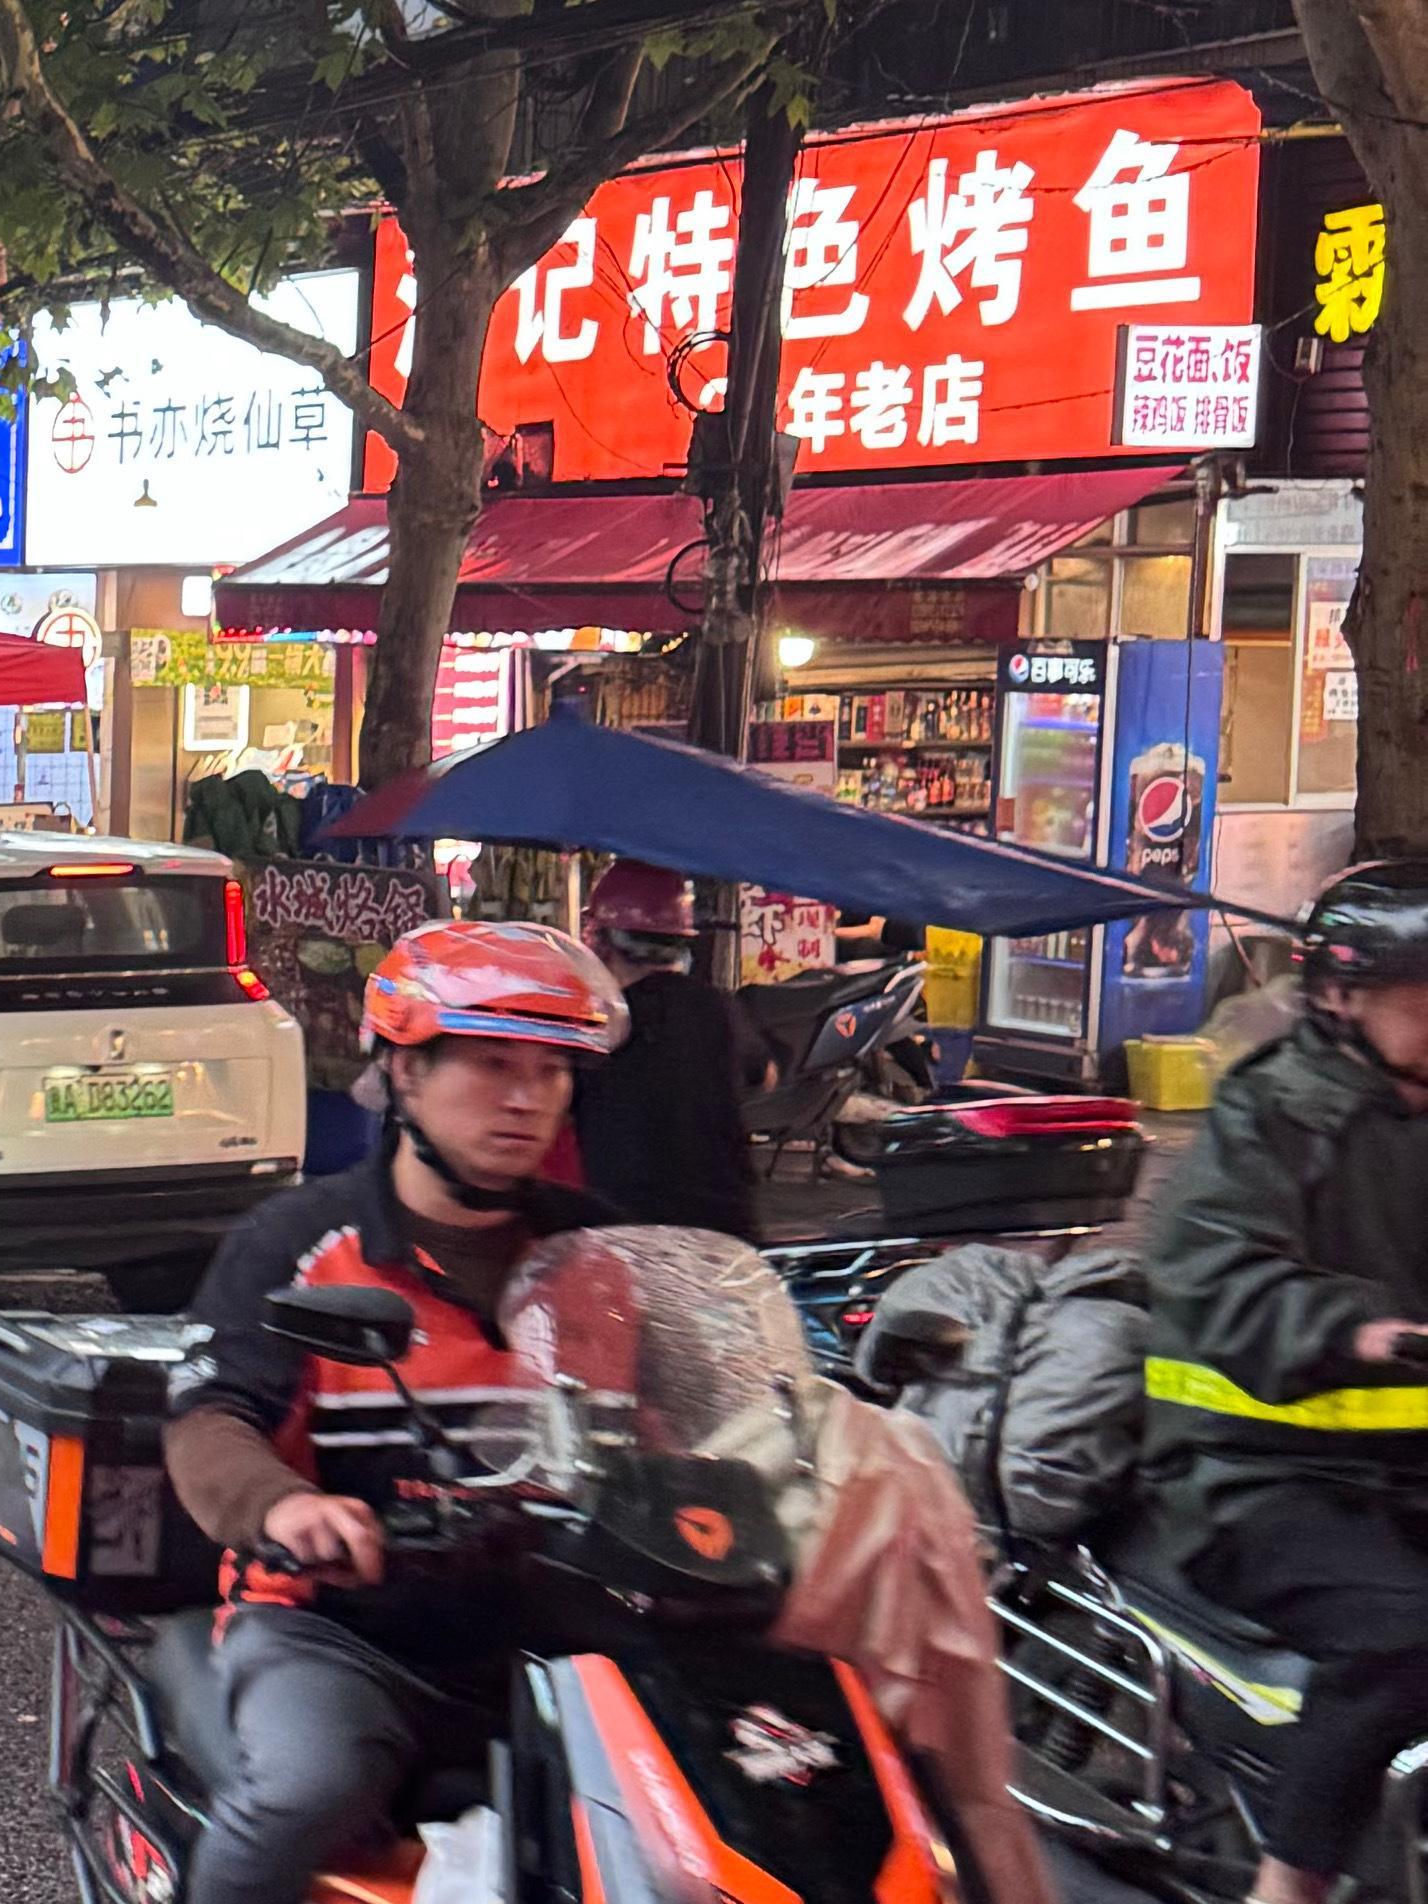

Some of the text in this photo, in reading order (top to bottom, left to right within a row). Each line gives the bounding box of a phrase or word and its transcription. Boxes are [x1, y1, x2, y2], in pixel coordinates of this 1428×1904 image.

[392, 128, 1202, 380] 记特色烤鱼
[107, 388, 329, 465] 书亦烧仙草
